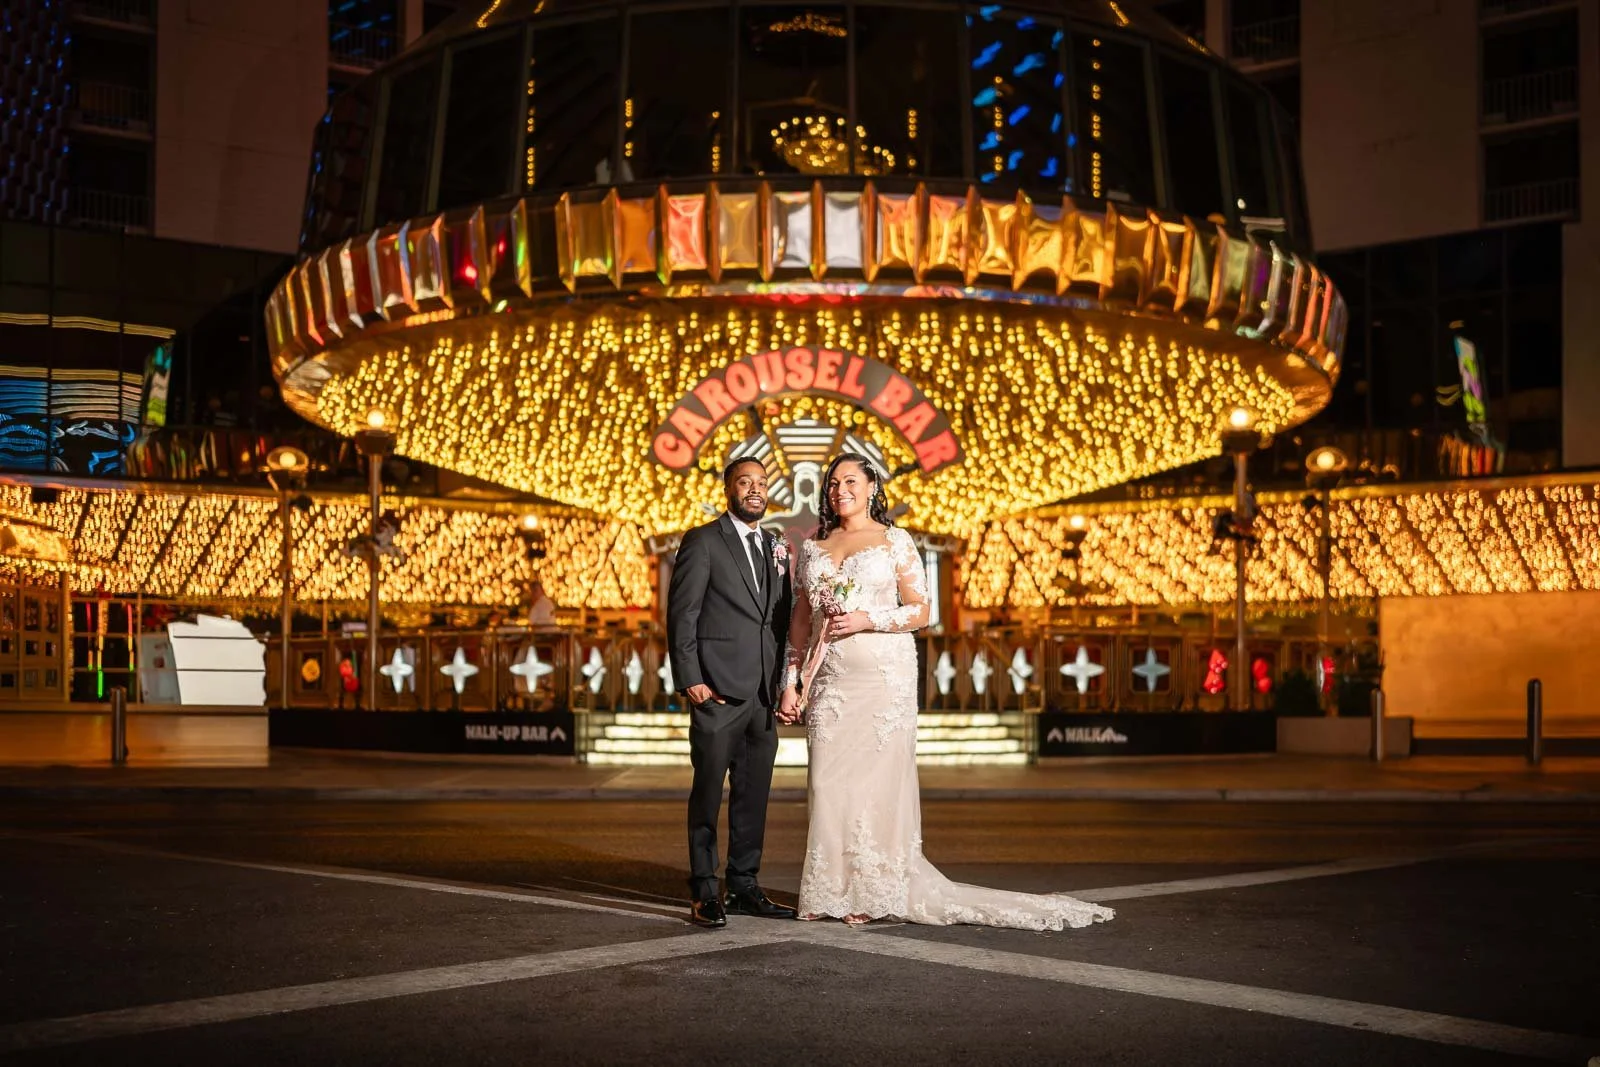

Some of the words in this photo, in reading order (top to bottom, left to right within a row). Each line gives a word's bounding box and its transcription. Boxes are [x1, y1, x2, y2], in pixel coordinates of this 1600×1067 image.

[653, 347, 866, 469] CAROUSEL
[869, 373, 959, 473] BAR
[465, 725, 520, 741] WALK-UP
[521, 725, 548, 741] BAR
